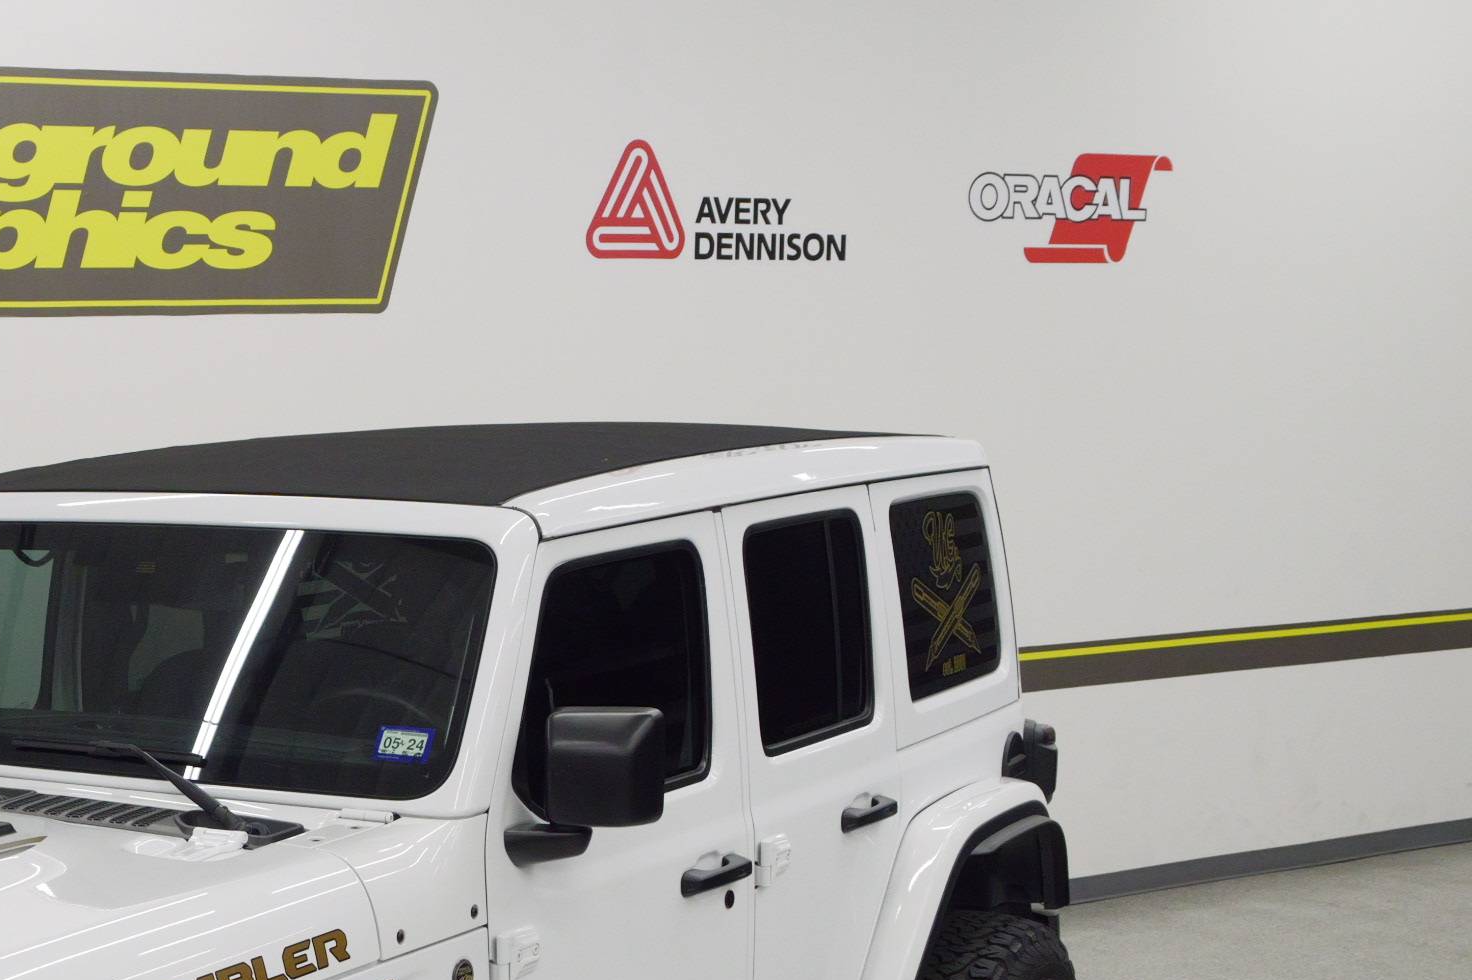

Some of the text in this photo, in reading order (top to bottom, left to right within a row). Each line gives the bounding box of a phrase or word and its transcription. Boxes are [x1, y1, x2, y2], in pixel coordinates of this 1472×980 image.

[695, 196, 791, 225] AVERY
[968, 172, 1147, 222] ORACAL
[694, 232, 847, 261] DENNISON
[383, 736, 425, 751] 05 24
